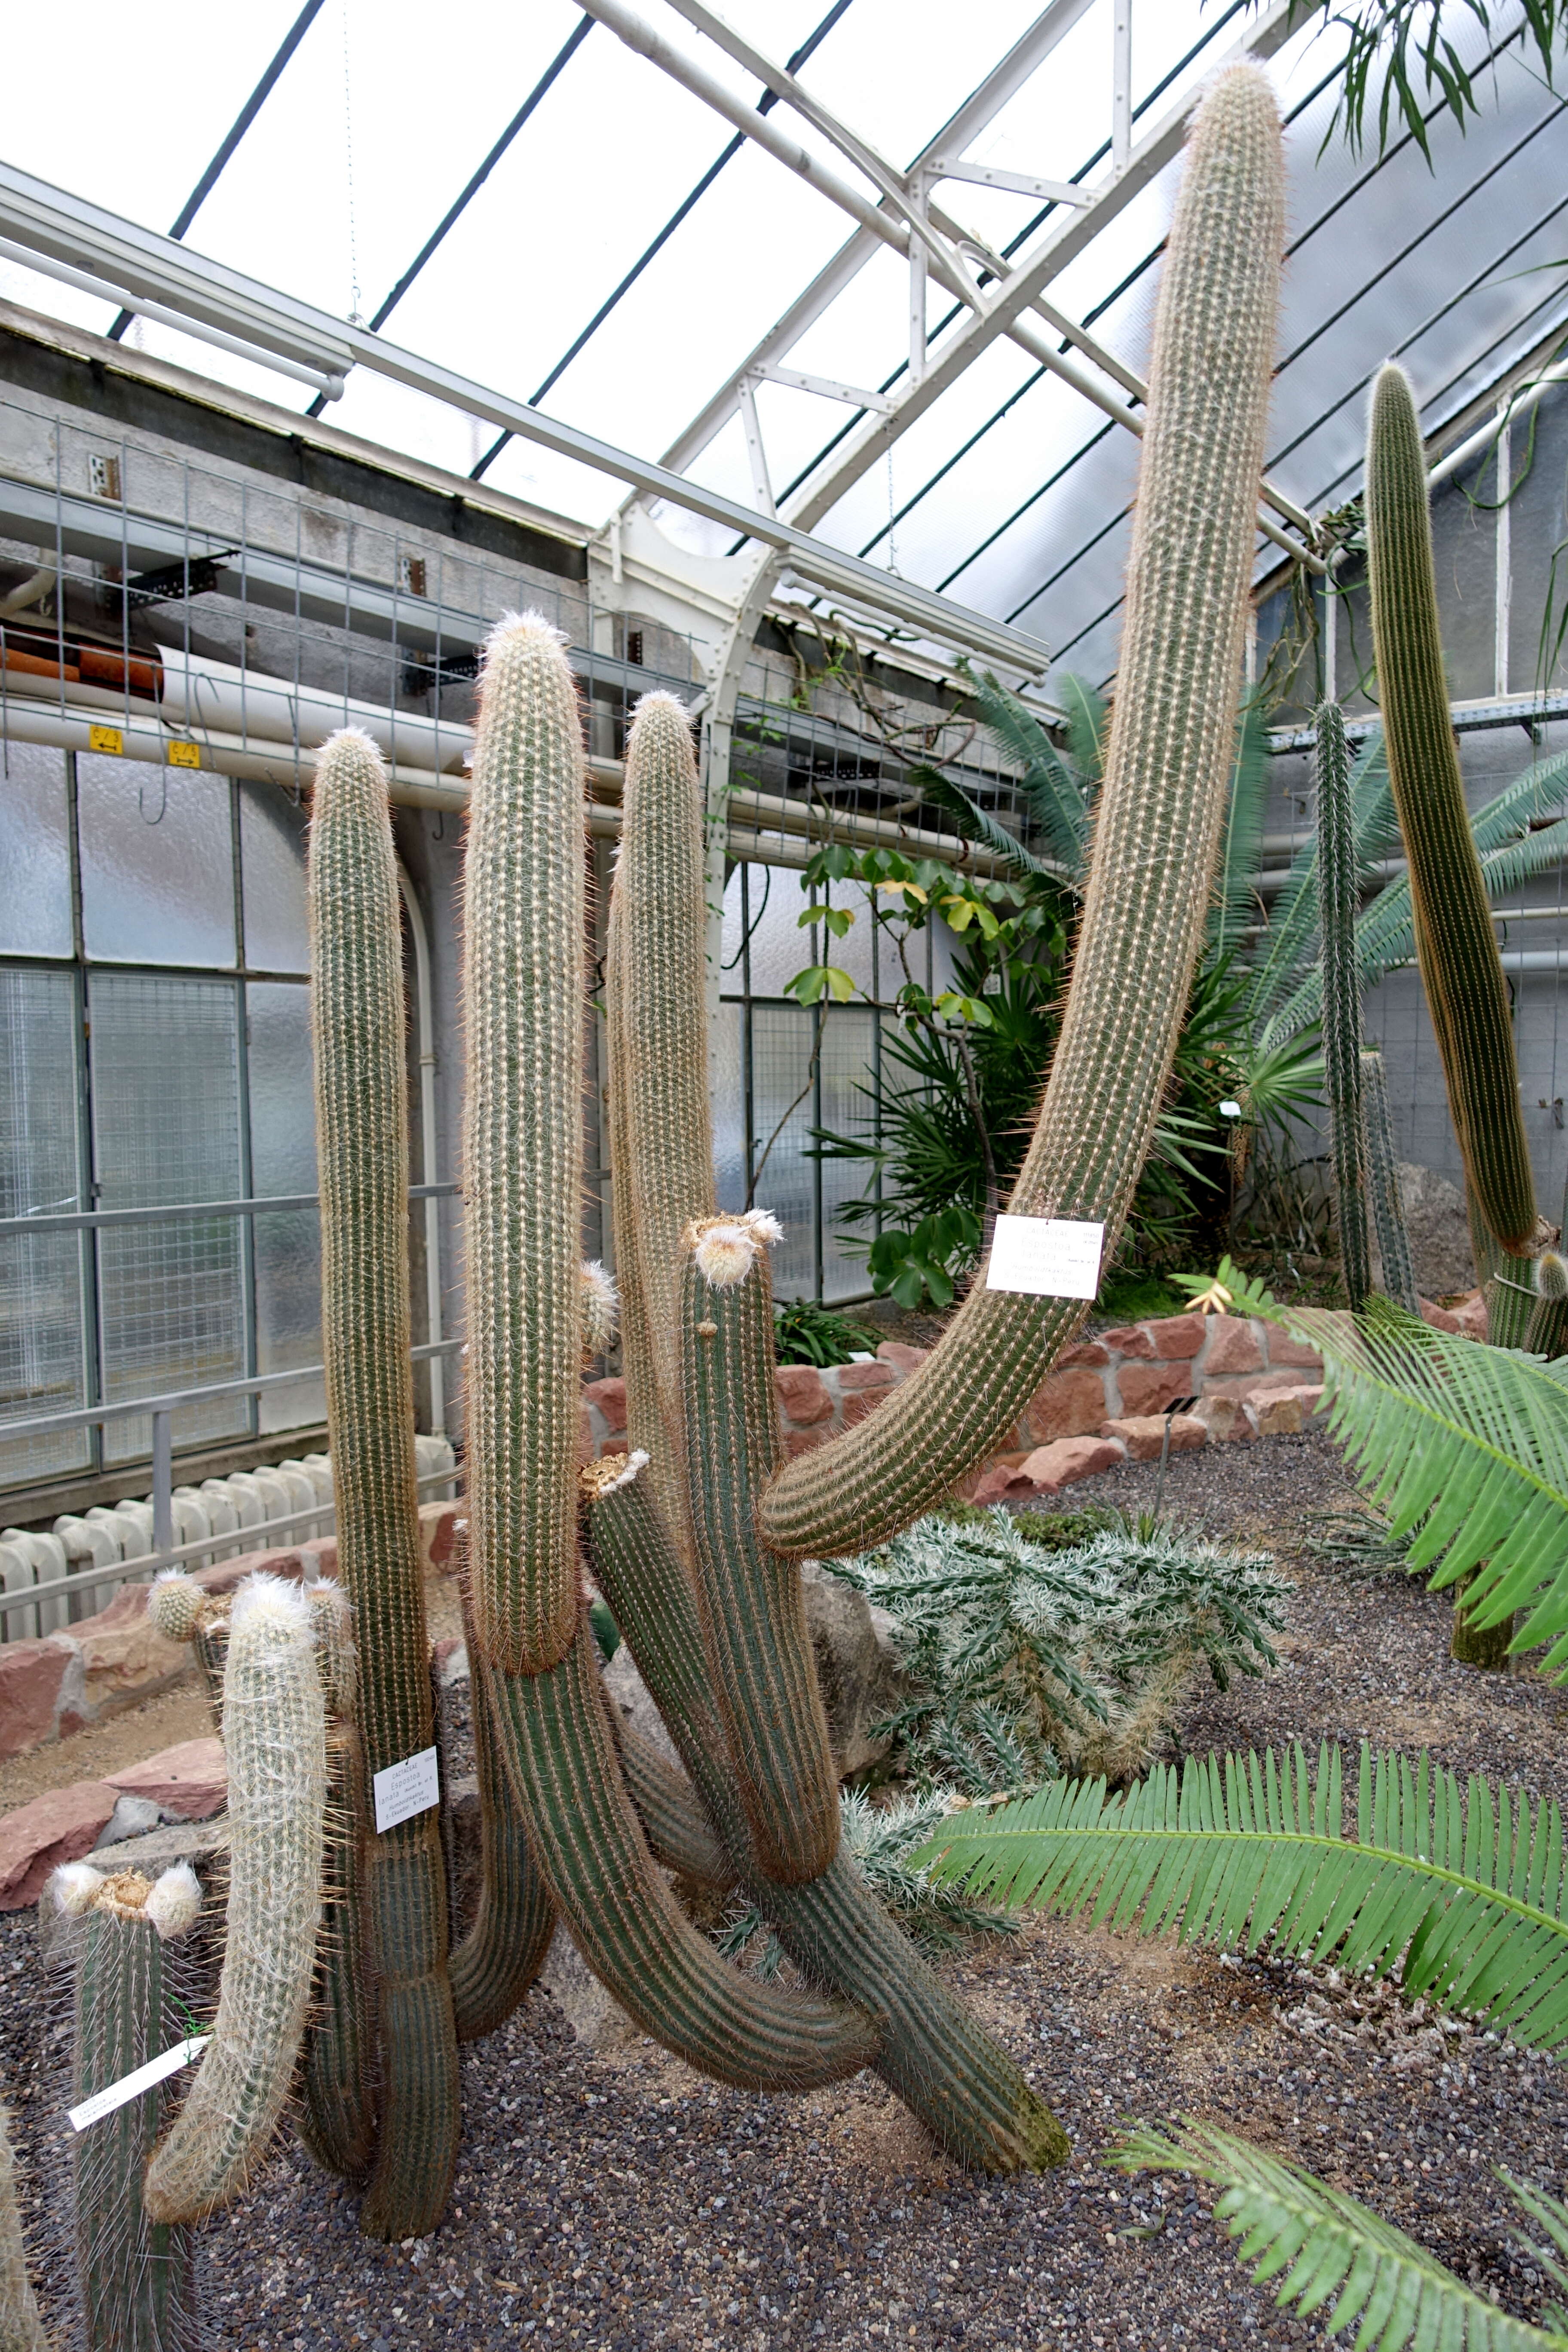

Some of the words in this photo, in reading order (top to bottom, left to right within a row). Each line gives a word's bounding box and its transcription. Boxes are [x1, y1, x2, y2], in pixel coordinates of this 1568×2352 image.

[1021, 1238, 1071, 1251] Espostoa
[392, 1763, 418, 1779] CACTACEAE
[391, 1771, 420, 1791] Espostoa
[379, 1791, 400, 1806] lanata
[413, 1795, 429, 1806] N-Peru
